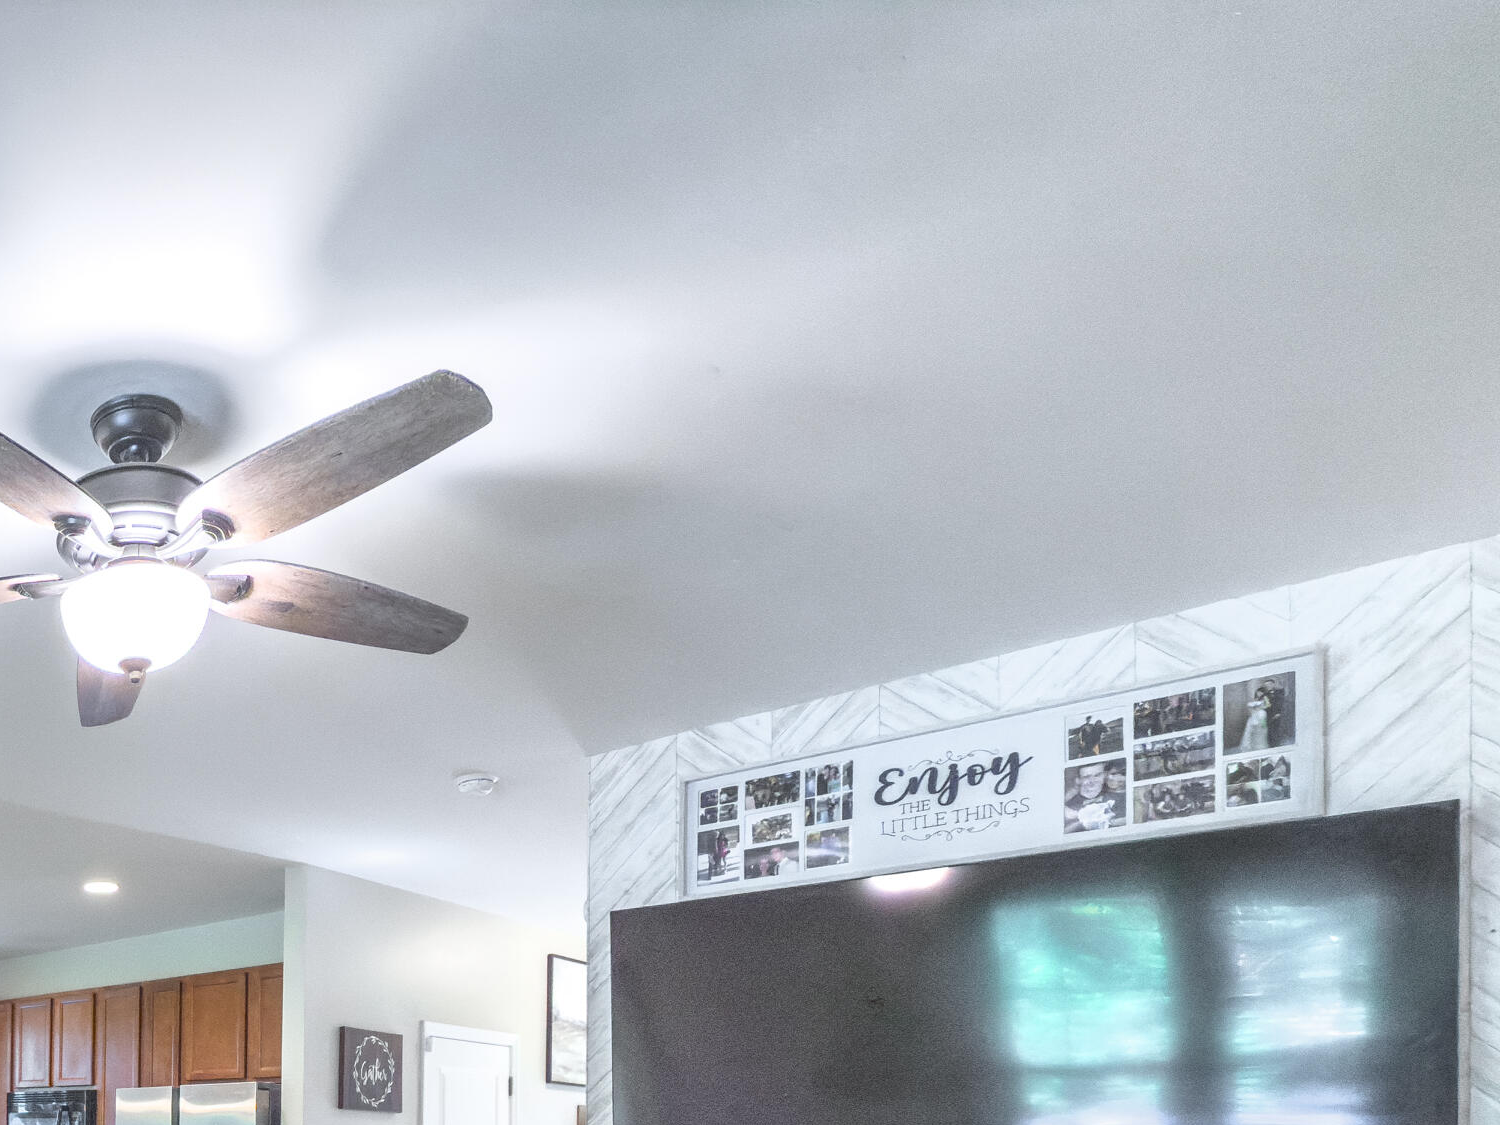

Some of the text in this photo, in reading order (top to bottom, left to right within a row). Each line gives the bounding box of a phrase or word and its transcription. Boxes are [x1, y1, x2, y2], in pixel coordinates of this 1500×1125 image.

[874, 752, 1033, 806] Enjoy
[880, 797, 1031, 836] LITTLE THINGS
[899, 799, 931, 815] THE
